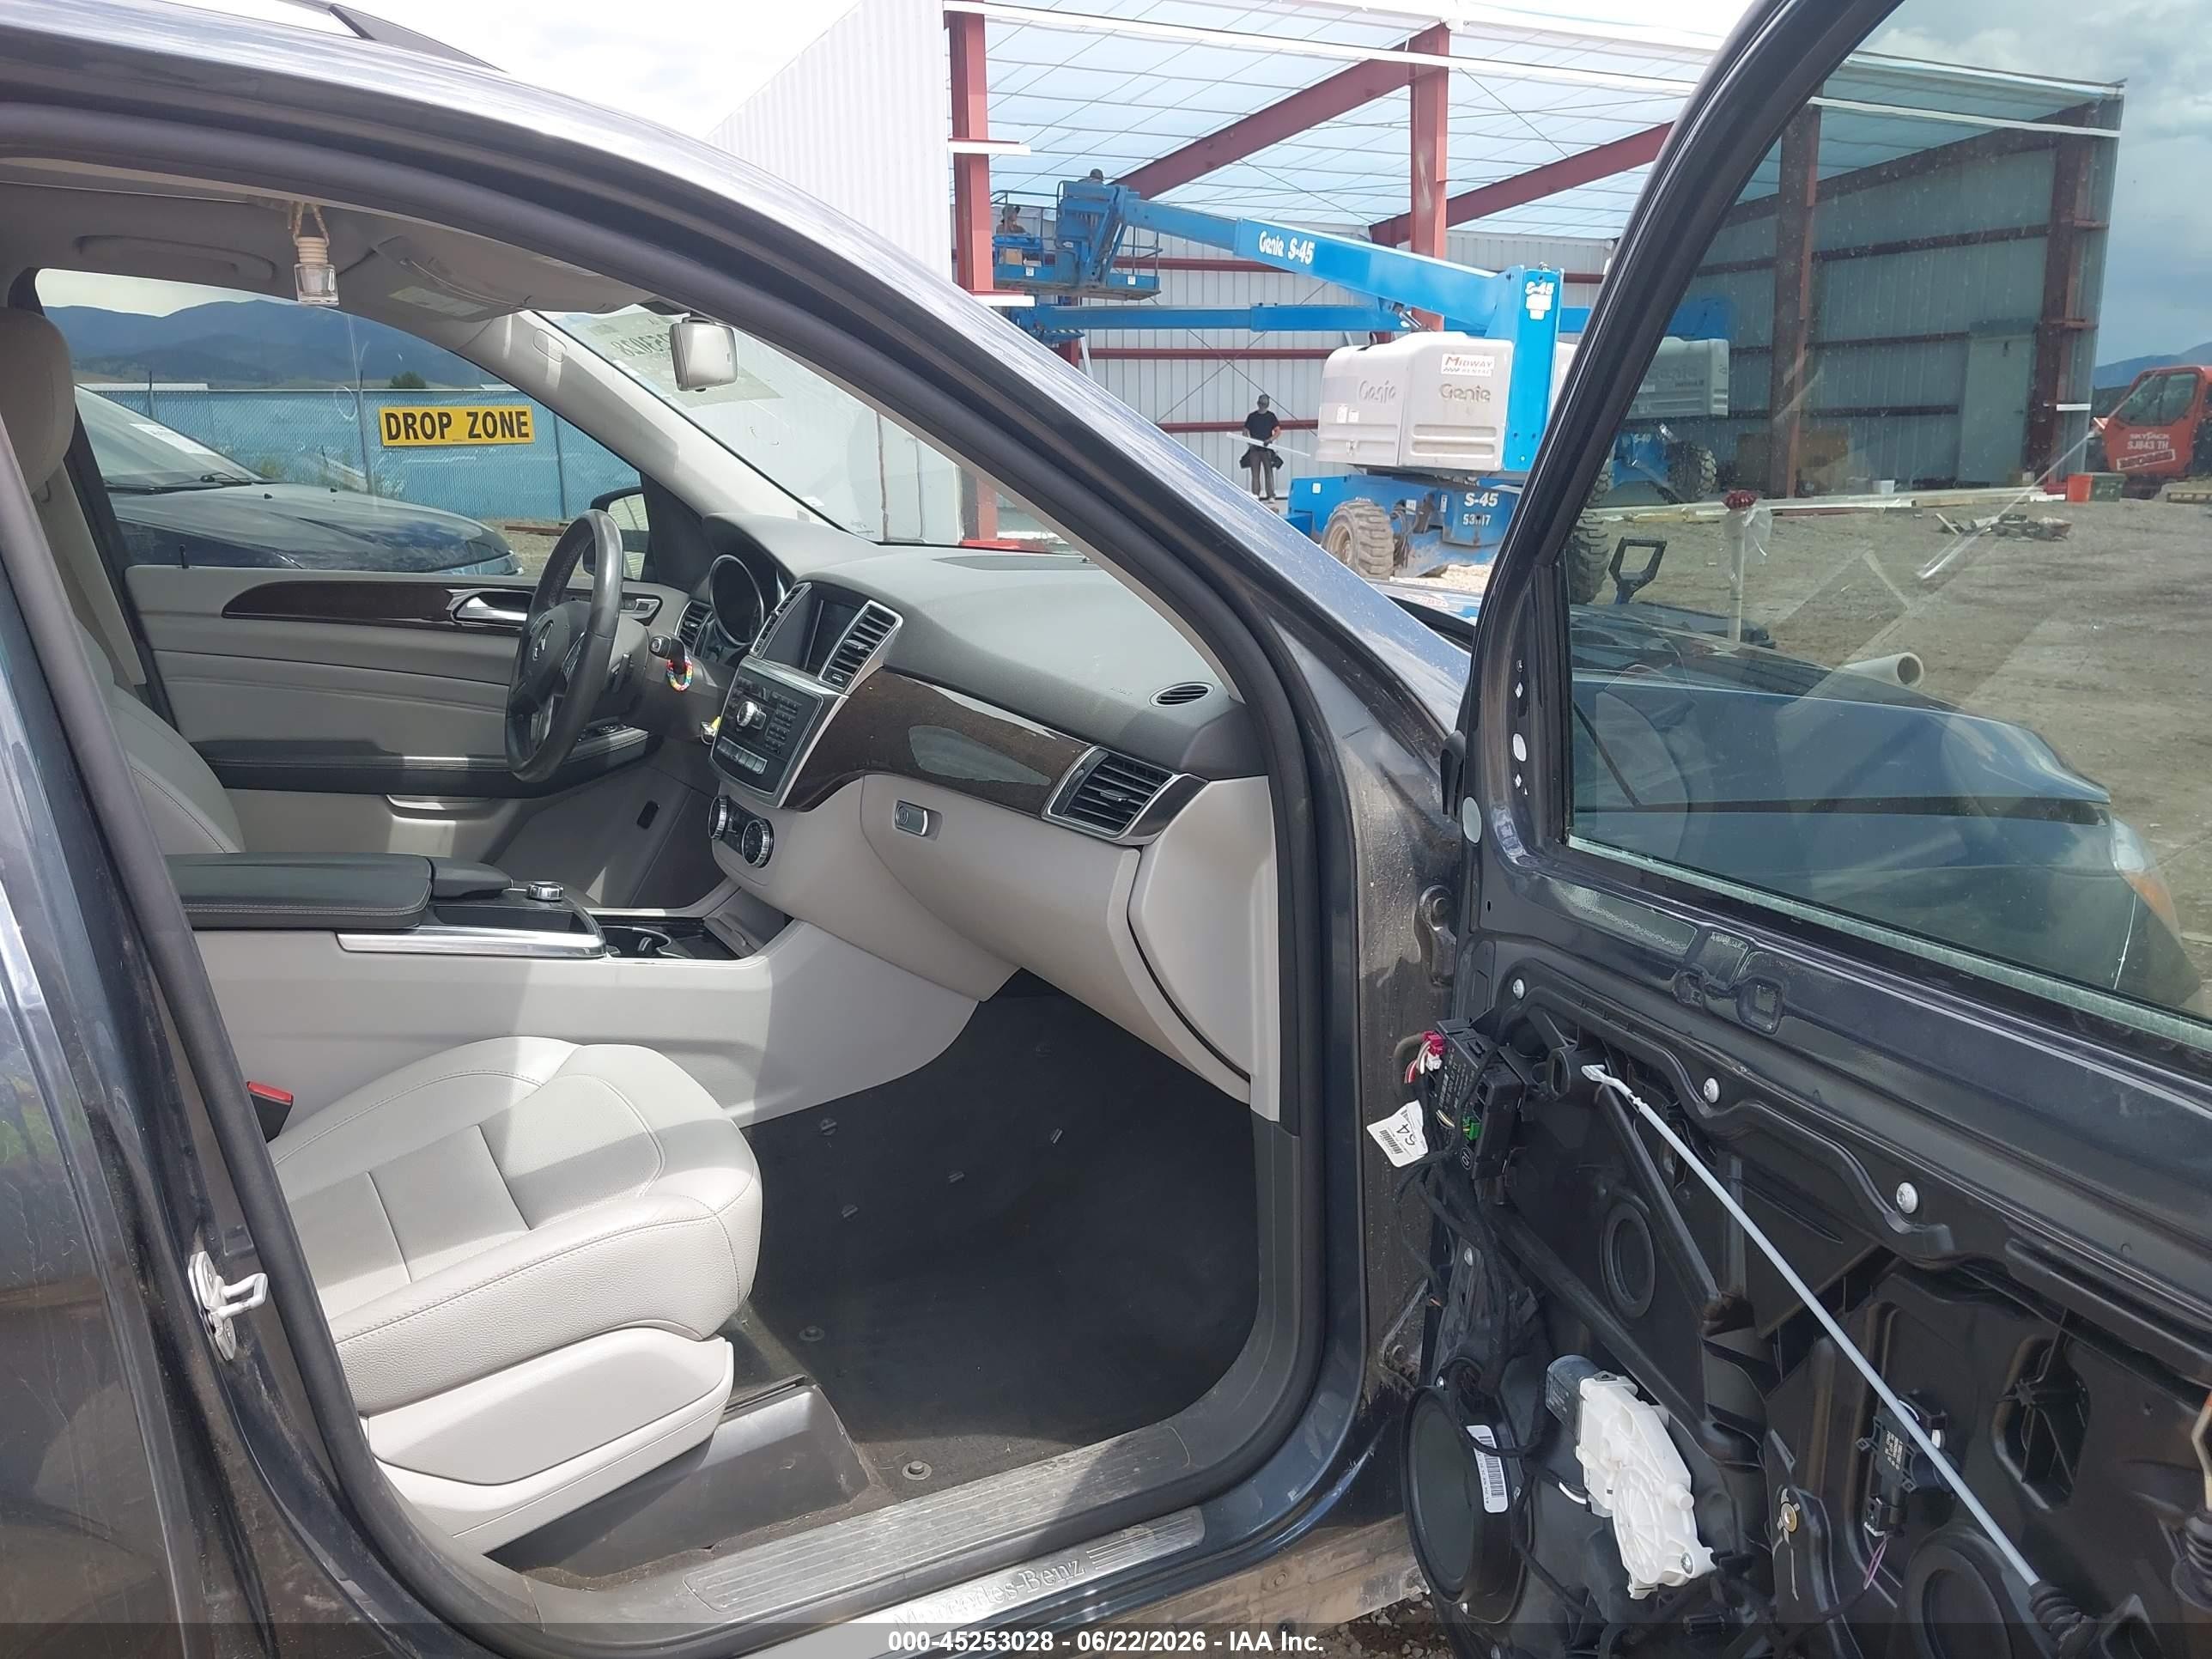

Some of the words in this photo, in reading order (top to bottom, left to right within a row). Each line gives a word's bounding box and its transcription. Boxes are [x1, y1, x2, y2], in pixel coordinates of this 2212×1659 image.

[1259, 230, 1284, 258] Genie
[1288, 237, 1315, 265] S-45
[1439, 383, 1492, 402] Genie
[385, 411, 453, 441] DROP
[466, 410, 530, 439] ZONE
[1464, 492, 1499, 507] S-45
